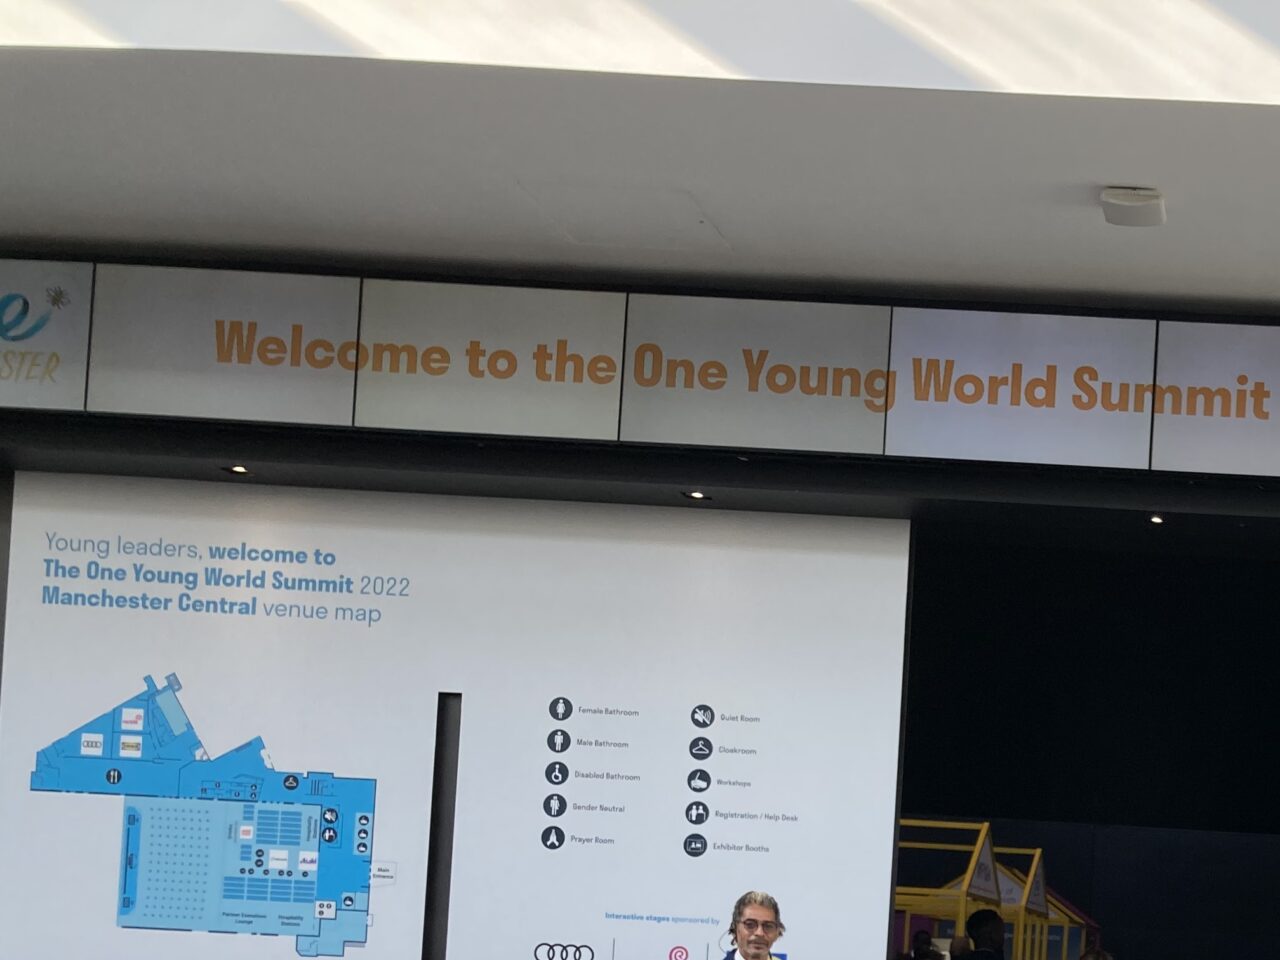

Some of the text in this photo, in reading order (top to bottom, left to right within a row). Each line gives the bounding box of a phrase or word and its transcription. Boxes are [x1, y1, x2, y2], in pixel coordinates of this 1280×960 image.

[215, 319, 1271, 421] Welcome to the One Young World Summit
[45, 532, 336, 566] Young leaders, welcome to
[43, 558, 411, 598] The One Young World Summit 2022
[42, 585, 382, 627] Manchester Central venue map
[578, 706, 639, 717] Female Bathroom
[720, 714, 760, 723] Quiet Room
[576, 738, 629, 749] Male Bathroom
[718, 746, 757, 755] Cloakroom
[574, 771, 641, 782] Disabled Bathroom
[716, 779, 751, 788] Workshops
[572, 803, 625, 813] Gender Neutral
[715, 810, 758, 822] Registration
[764, 813, 780, 822] Help
[781, 814, 798, 822] Desk
[570, 835, 615, 845] Prayer Room
[713, 842, 770, 853] Exhibitor Booths
[605, 911, 720, 926] Interactive stages sponsored by
